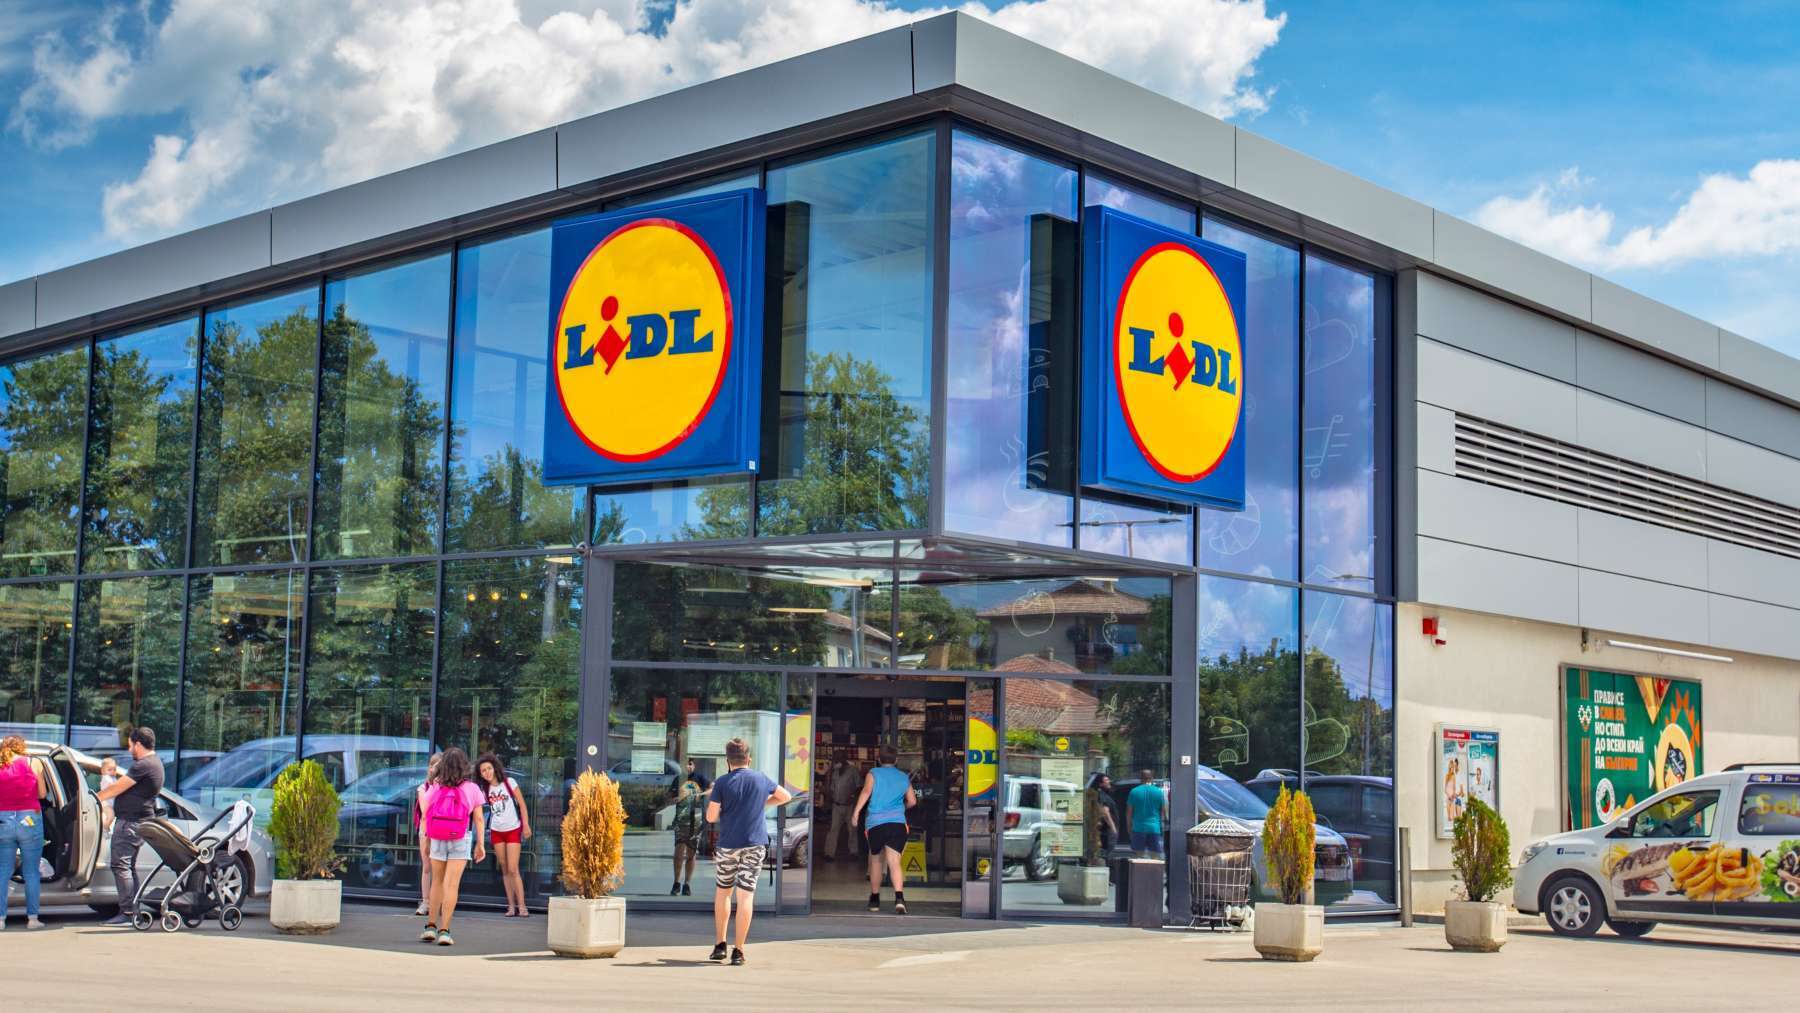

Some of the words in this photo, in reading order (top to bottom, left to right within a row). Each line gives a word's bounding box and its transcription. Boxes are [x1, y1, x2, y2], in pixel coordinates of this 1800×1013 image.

[1594, 705, 1600, 719] В
[1594, 721, 1605, 735] НО
[1605, 722, 1625, 737] СТИГА
[1594, 737, 1606, 755] ДО
[1606, 738, 1627, 753] ВСЕКИ
[1627, 736, 1645, 754] КРАЙ
[1595, 755, 1605, 769] НА
